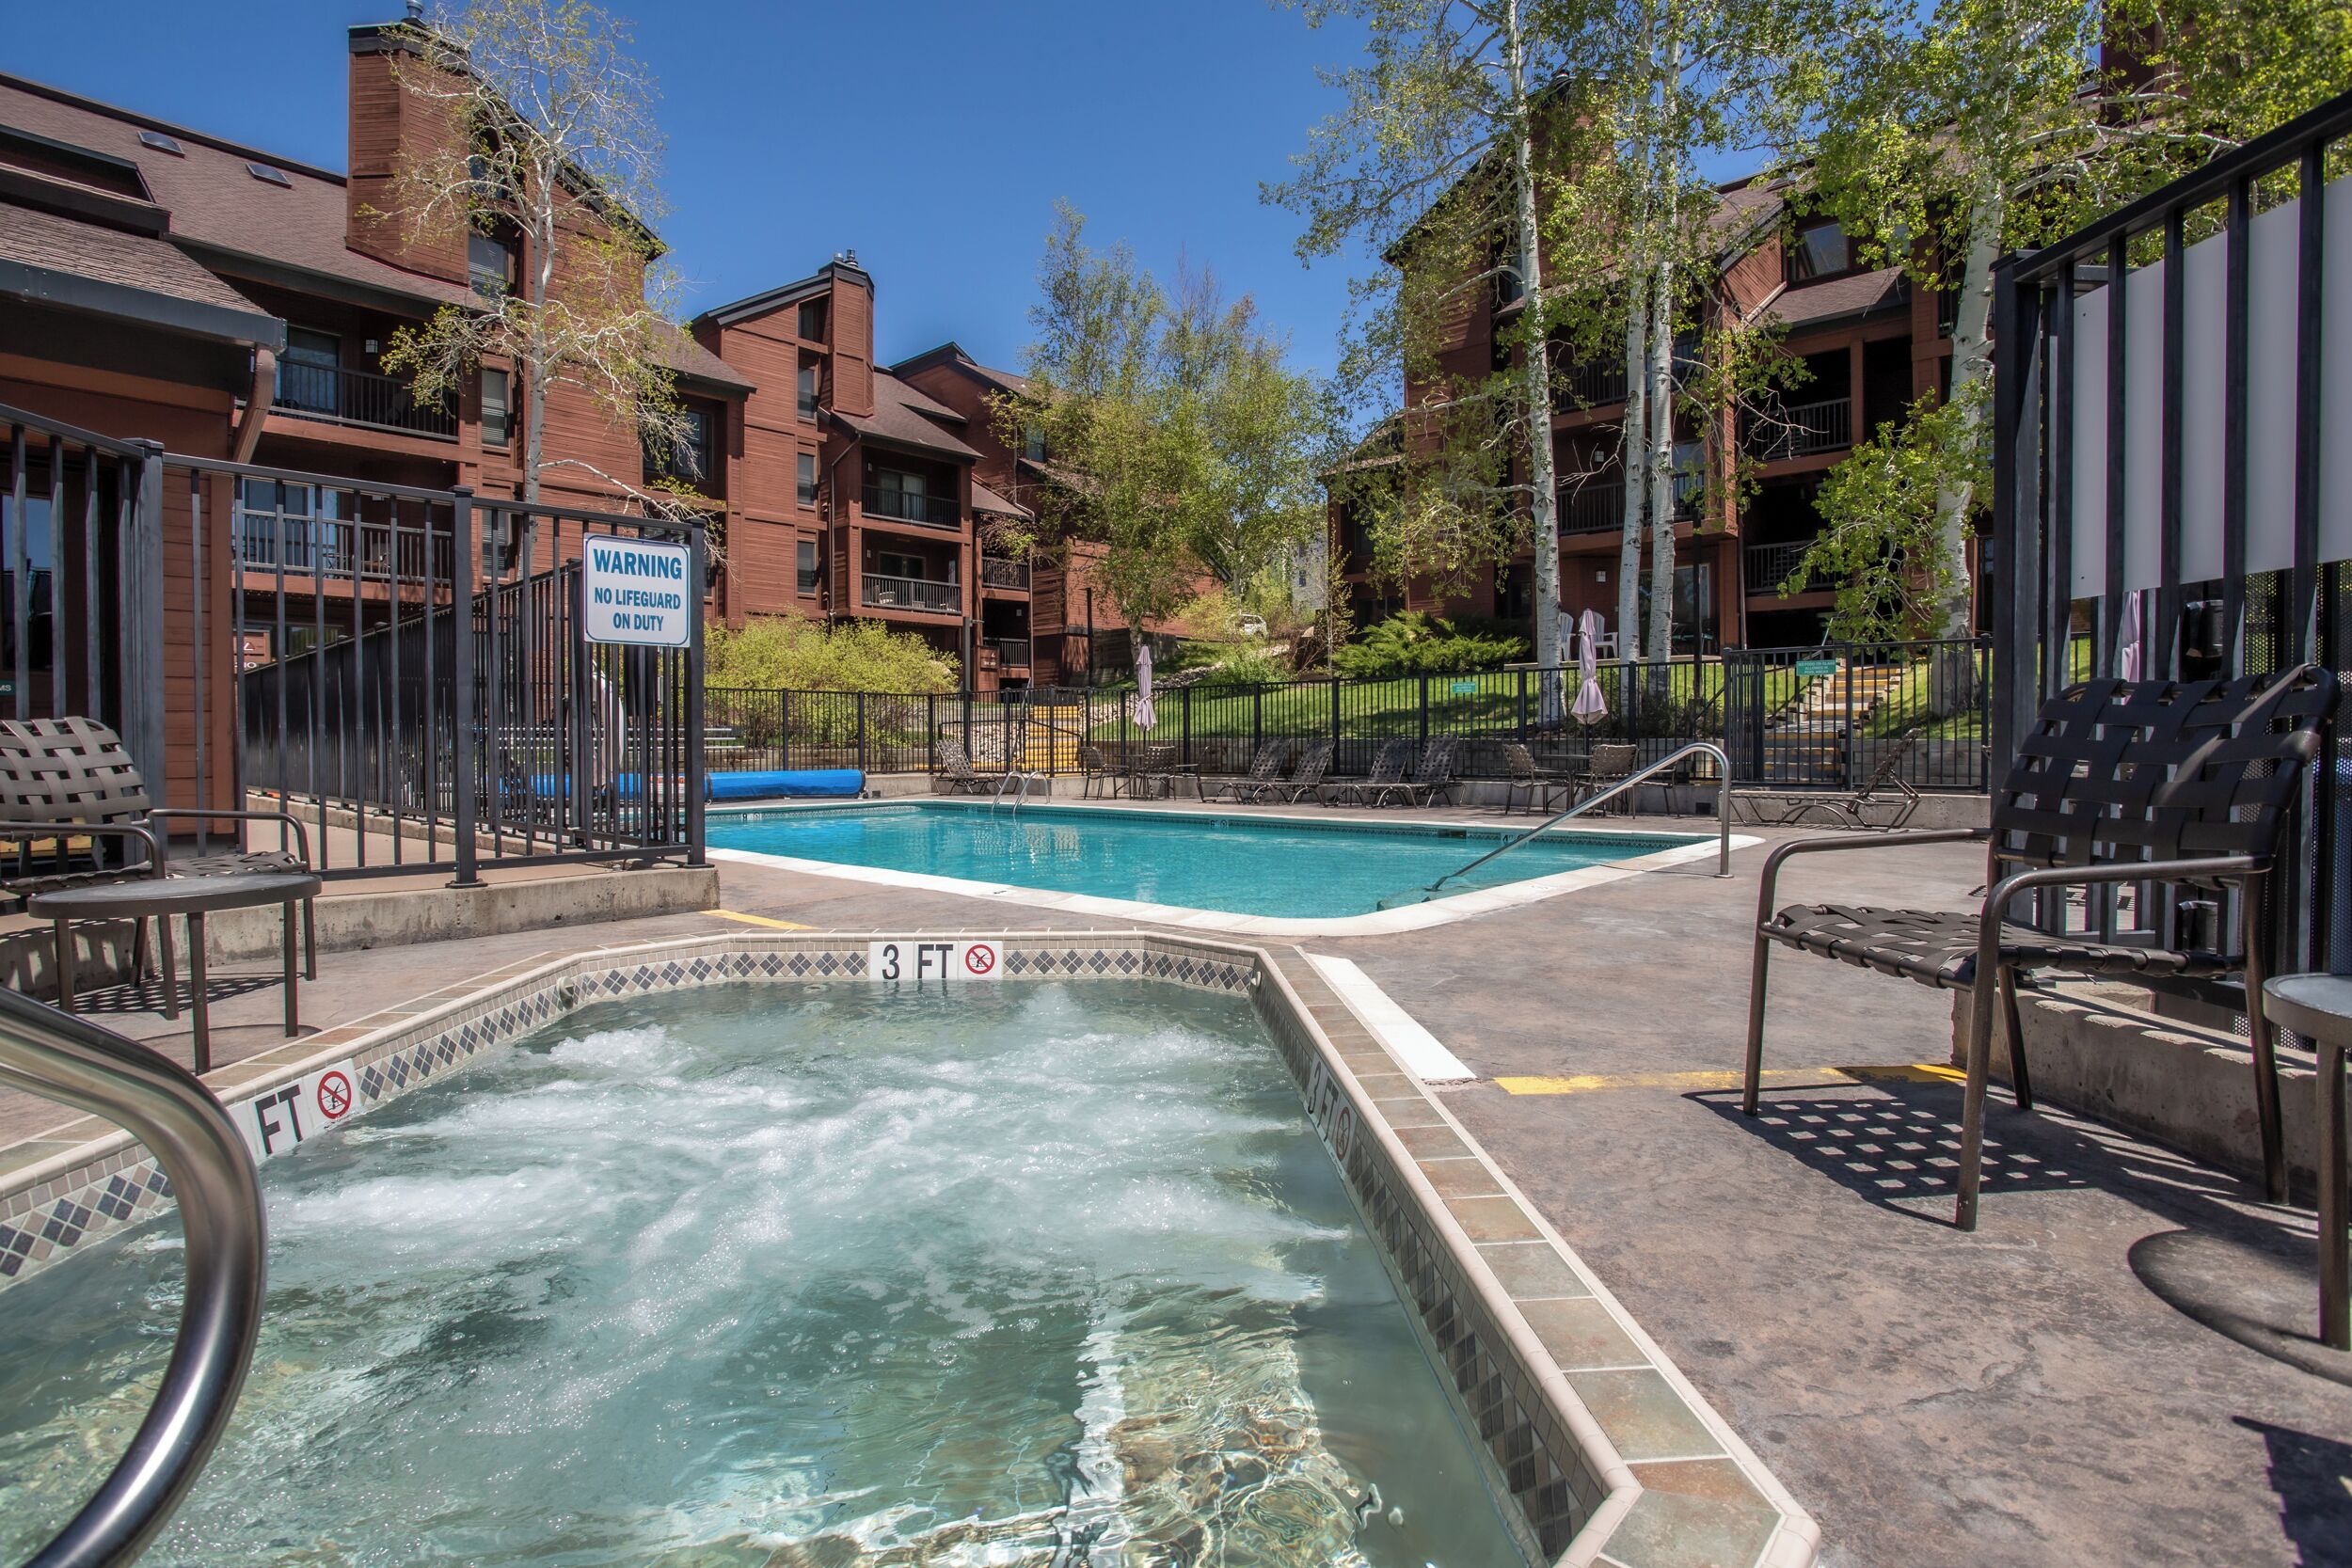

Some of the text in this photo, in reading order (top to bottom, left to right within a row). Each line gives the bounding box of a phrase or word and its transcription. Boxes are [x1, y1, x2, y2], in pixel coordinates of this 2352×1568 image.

[593, 548, 682, 579] WARNING
[594, 587, 681, 610] NO LIFEGUARD
[612, 612, 664, 631] ON DUTY
[882, 943, 954, 979] 3 FT
[1307, 1060, 1321, 1115] 3
[1317, 1075, 1340, 1143] FT
[255, 1084, 304, 1155] FT
